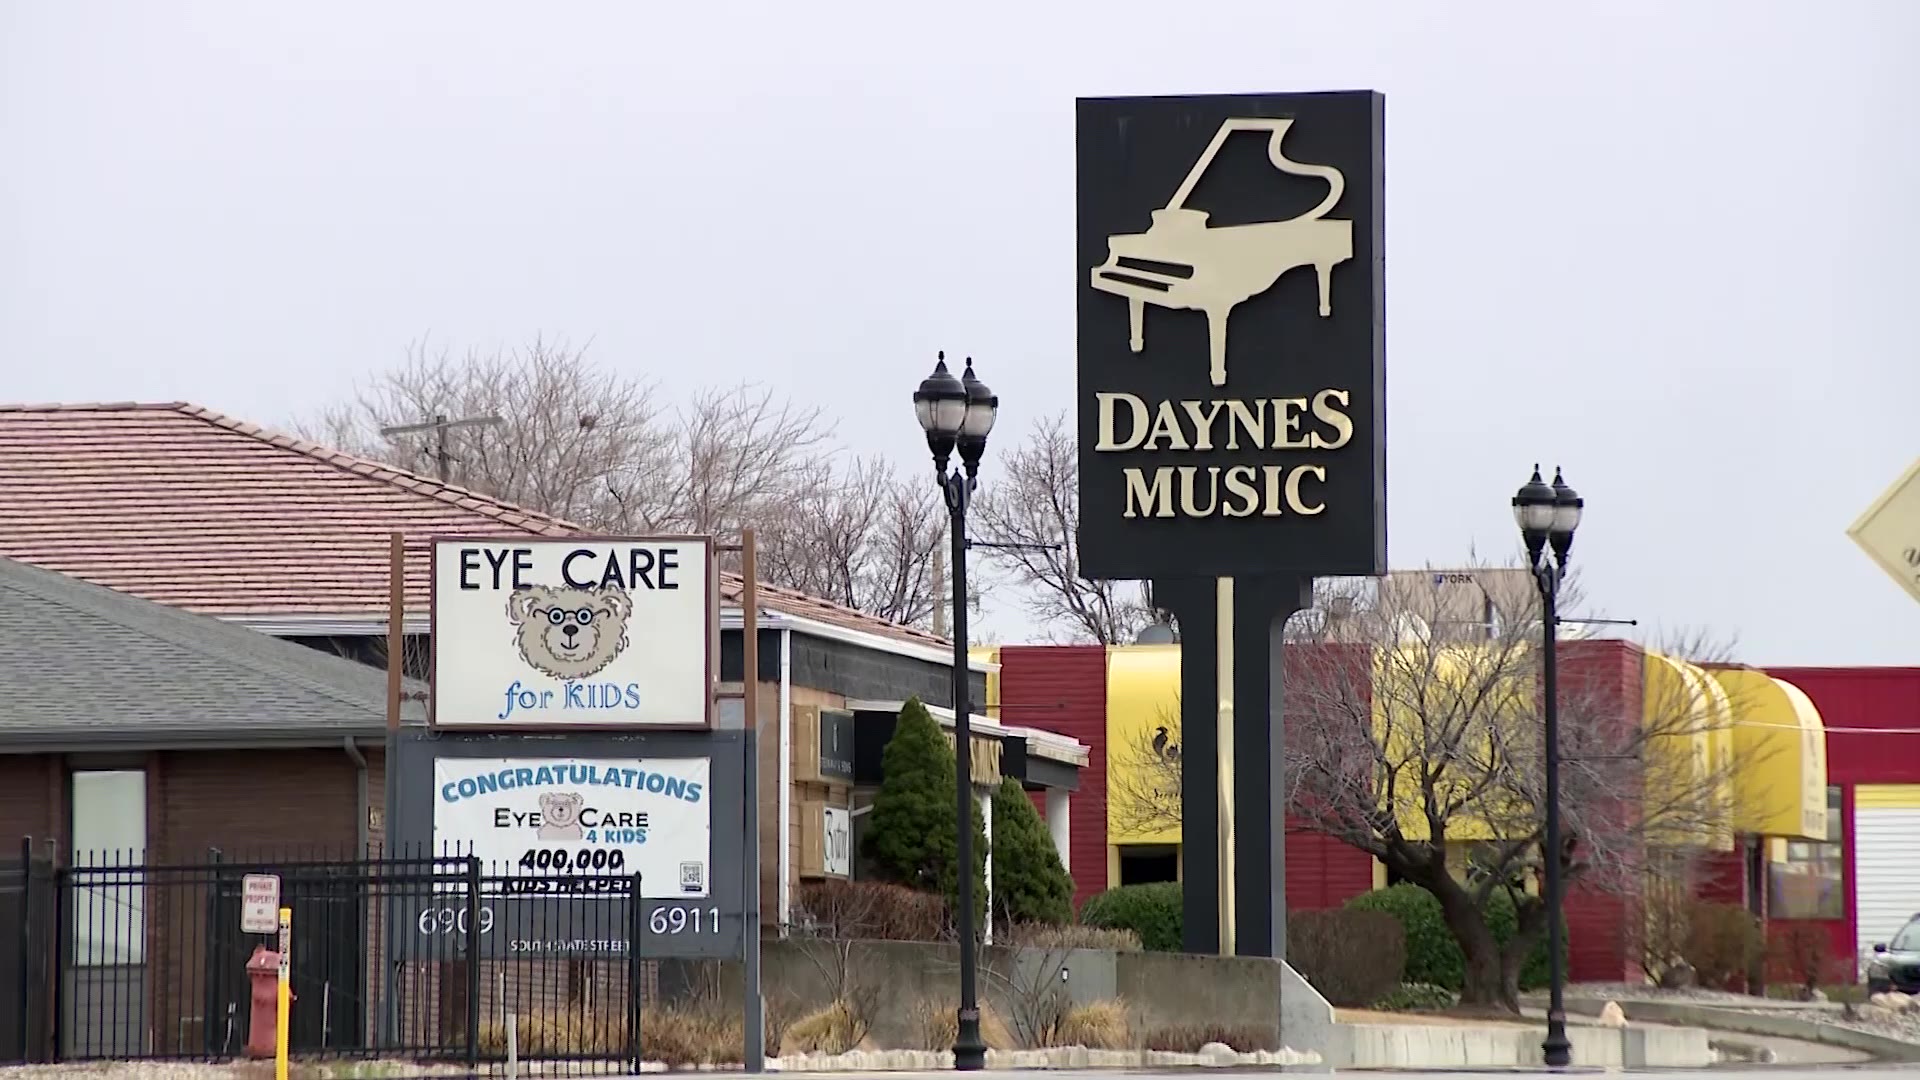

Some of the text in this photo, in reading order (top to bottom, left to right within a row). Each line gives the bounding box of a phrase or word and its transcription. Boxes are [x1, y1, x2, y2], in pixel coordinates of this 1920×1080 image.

[1095, 389, 1353, 452] DAYNES
[1123, 465, 1326, 518] MUSIC
[460, 548, 679, 590] EYE CARE
[498, 680, 641, 720] for KIDS
[442, 764, 702, 803] CONGRATULATIONS
[586, 829, 647, 844] 4 KIDS
[519, 849, 625, 874] 400,000
[649, 906, 719, 934] 6911
